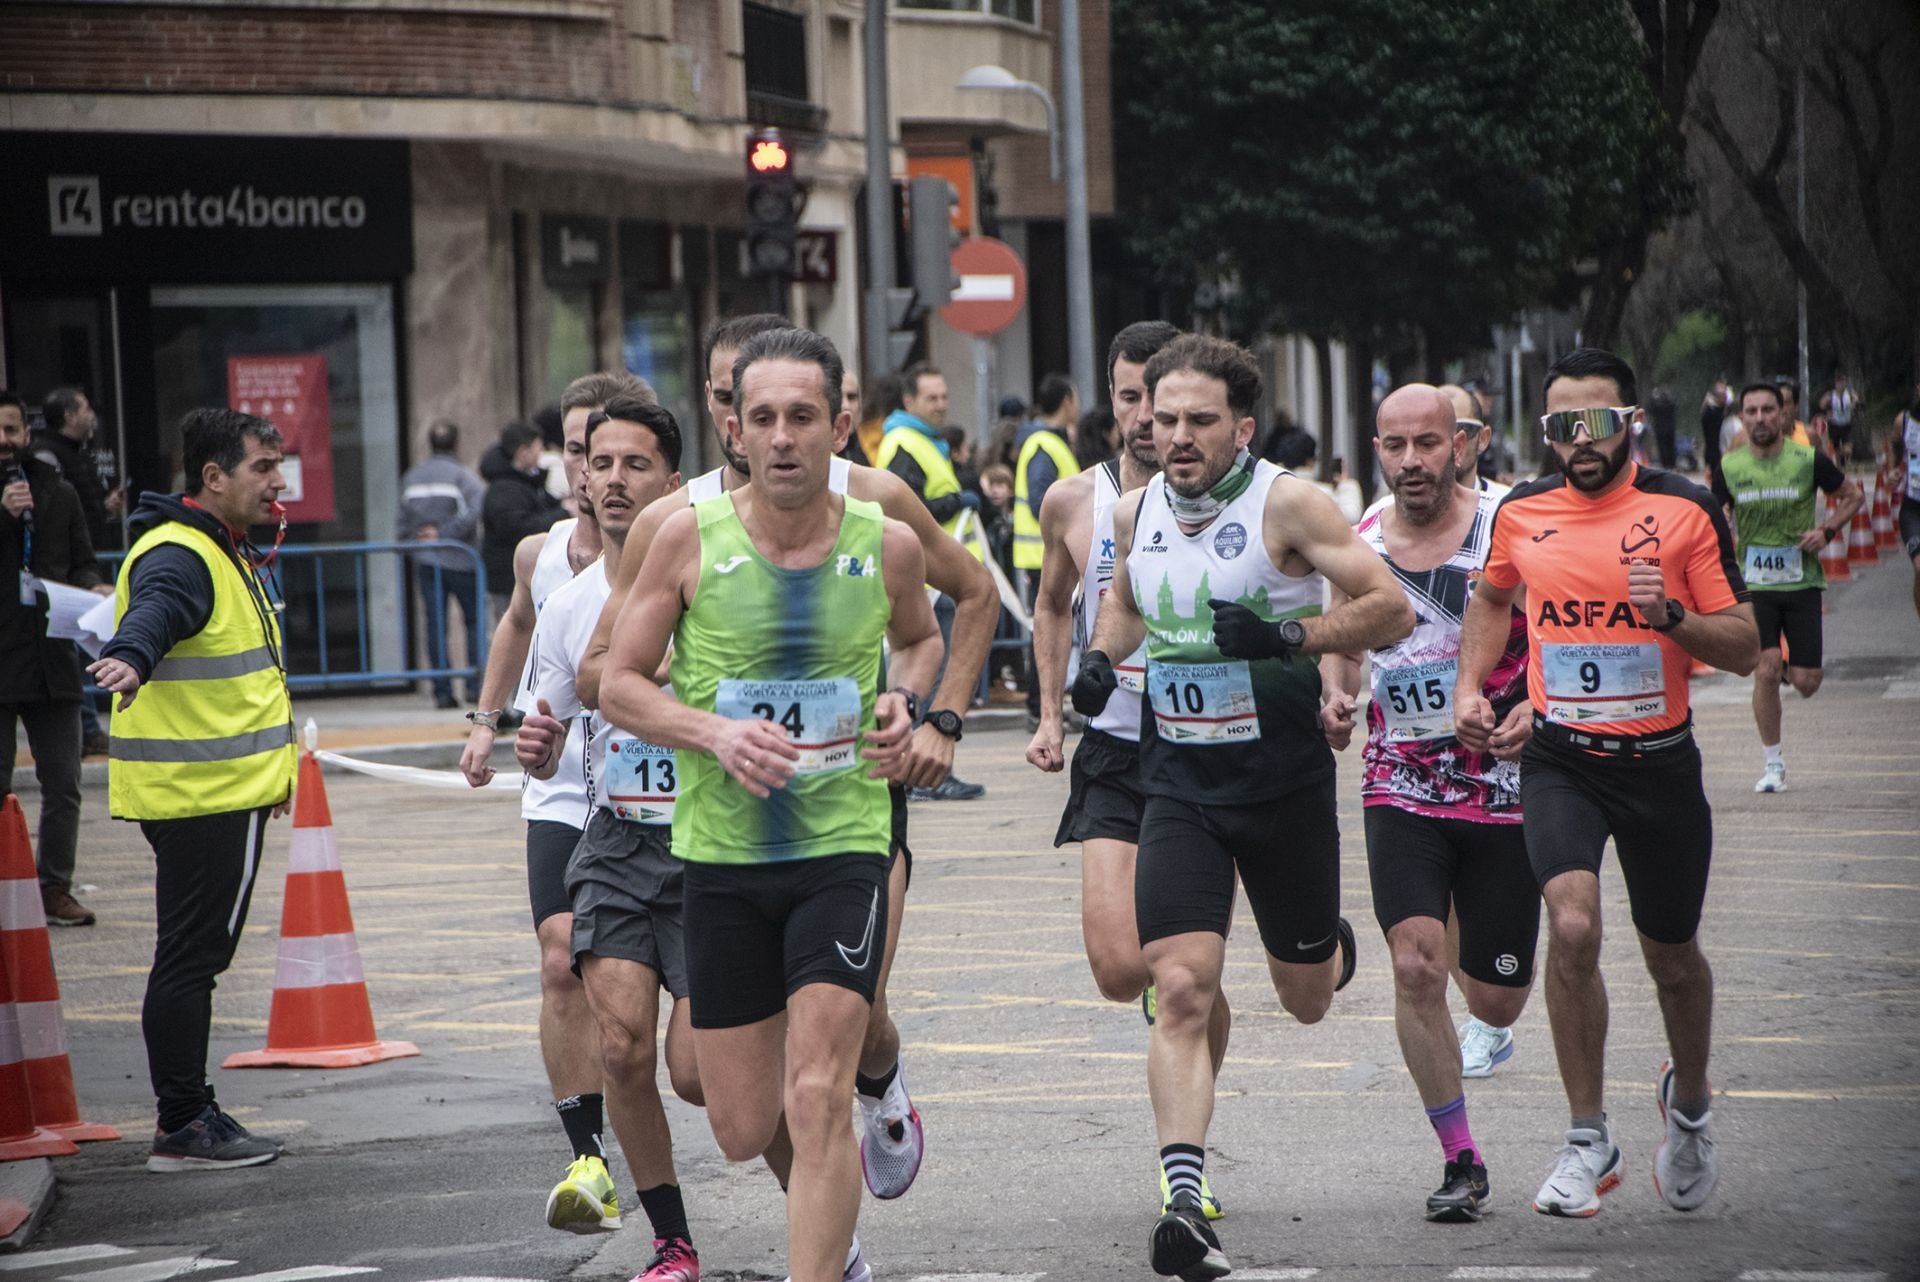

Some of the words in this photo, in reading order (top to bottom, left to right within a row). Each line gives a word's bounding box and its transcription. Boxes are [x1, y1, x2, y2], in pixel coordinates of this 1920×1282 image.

[112, 186, 367, 228] renta4banco
[1142, 545, 1168, 553] VIATOR
[835, 553, 877, 577] P&A
[1753, 555, 1785, 571] 448
[1580, 661, 1600, 694] 9
[744, 688, 777, 697] VUELTA
[780, 688, 790, 697] AL
[1165, 682, 1205, 714] 10
[1387, 678, 1446, 714] 515
[1634, 702, 1660, 713] HOY
[1227, 725, 1253, 735] HOY
[625, 746, 654, 755] VUELTA
[656, 746, 665, 754] AL
[824, 749, 850, 763] HOY
[635, 758, 676, 793] 13
